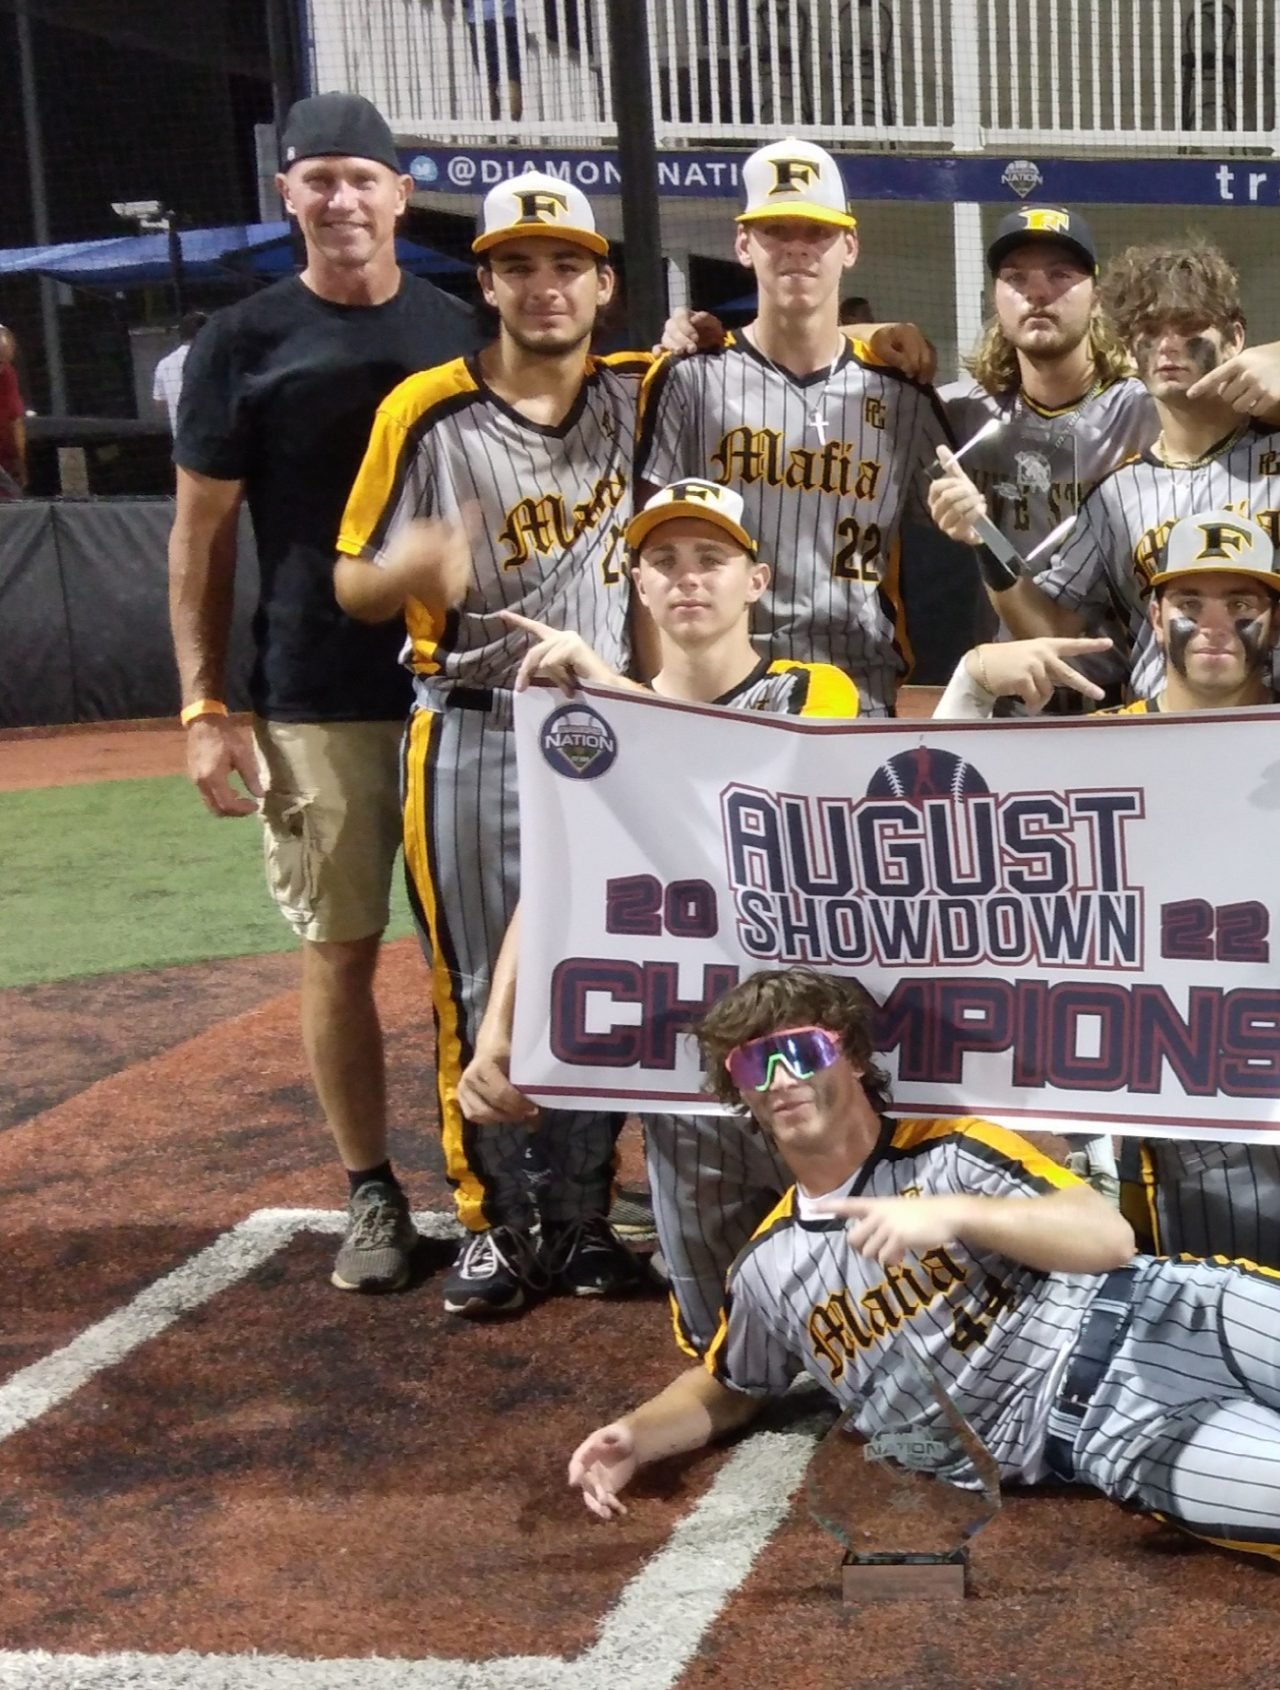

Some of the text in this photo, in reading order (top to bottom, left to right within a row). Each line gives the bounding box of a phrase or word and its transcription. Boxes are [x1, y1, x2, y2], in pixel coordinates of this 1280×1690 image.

[512, 189, 569, 224] F
[767, 156, 822, 195] F
[711, 426, 882, 502] Mafia
[834, 516, 883, 583] 22
[1196, 522, 1253, 561] F
[544, 733, 614, 753] NATION
[721, 782, 1144, 897] AUGUST
[605, 873, 718, 939] 20
[734, 890, 1143, 972] SHOWDOWN
[1160, 897, 1270, 963] 22
[806, 1245, 967, 1382] Mafia
